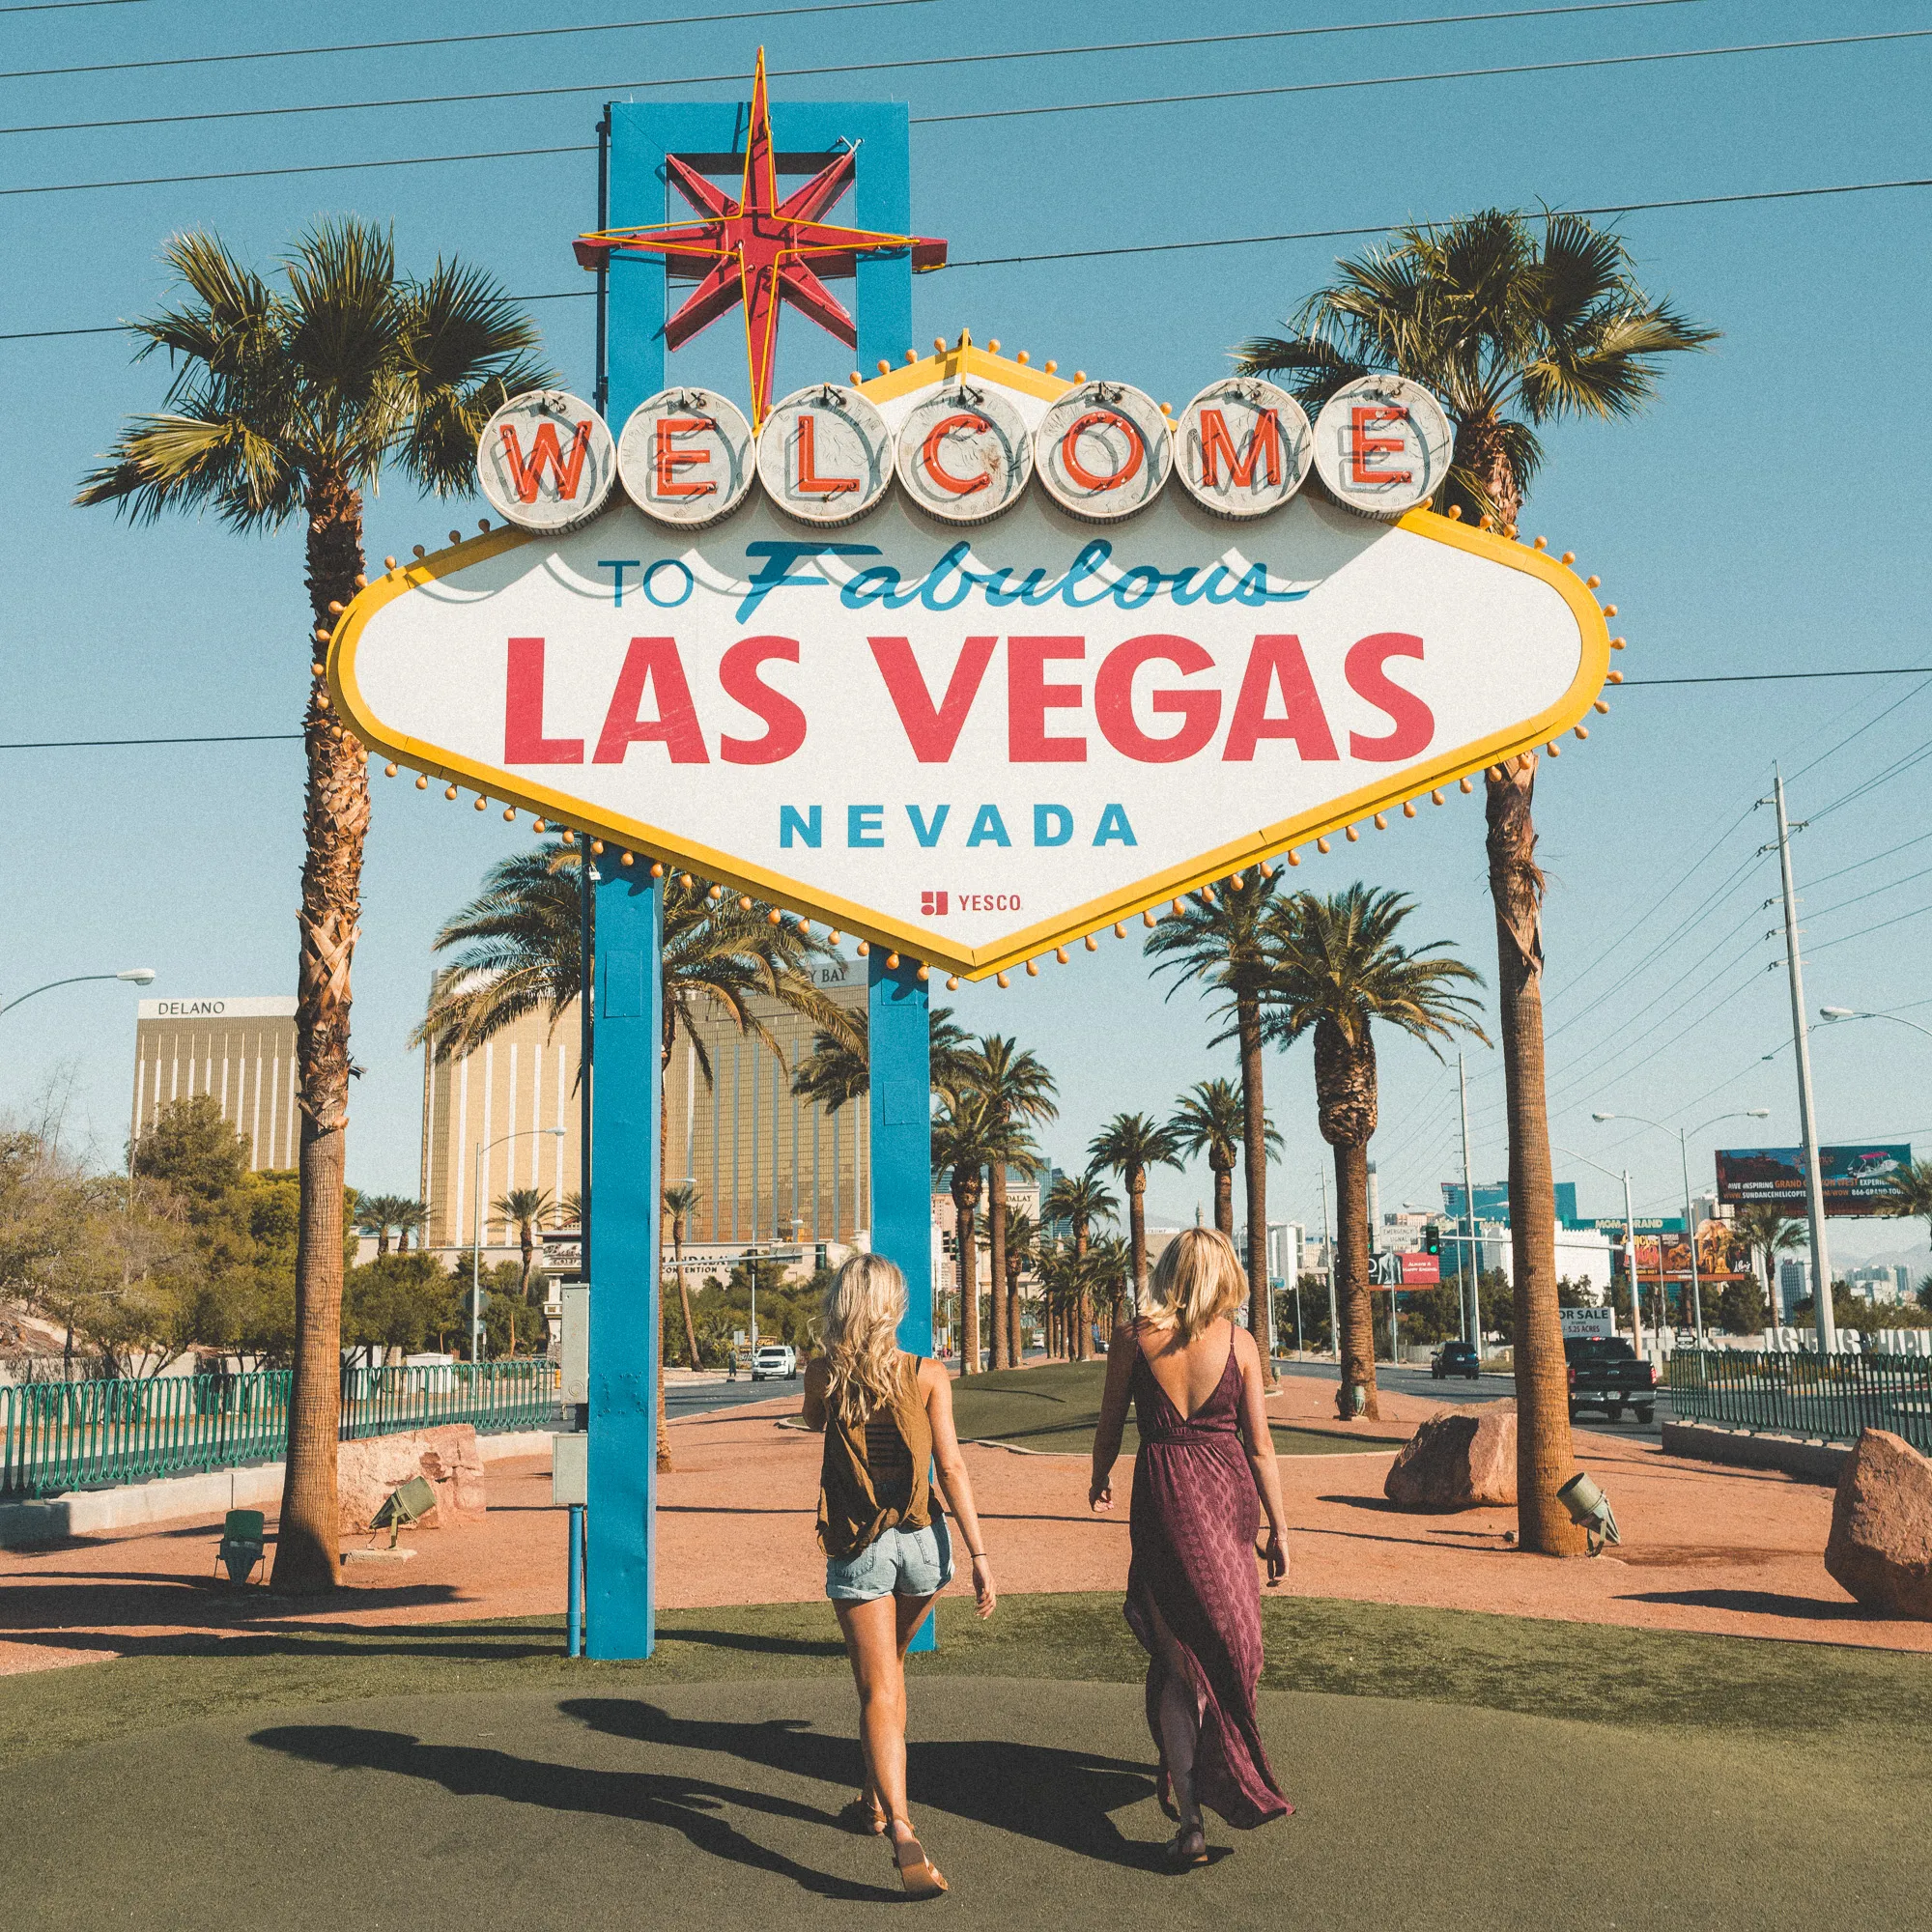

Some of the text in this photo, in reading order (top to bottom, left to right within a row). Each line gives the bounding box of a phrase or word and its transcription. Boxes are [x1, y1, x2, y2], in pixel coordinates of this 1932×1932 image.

[501, 406, 1413, 503] WELCOME
[598, 539, 1311, 625] TO Fabulous
[504, 633, 1435, 765] LAS VEGAS
[781, 804, 1137, 848] NEVADA
[958, 895, 1021, 911] YESCO
[821, 968, 846, 982] BAY
[158, 1002, 225, 1014] DELANO
[1775, 1179, 1802, 1188] GRAND
[1577, 1309, 1609, 1320] SALE
[1581, 1324, 1600, 1333] ACRES
